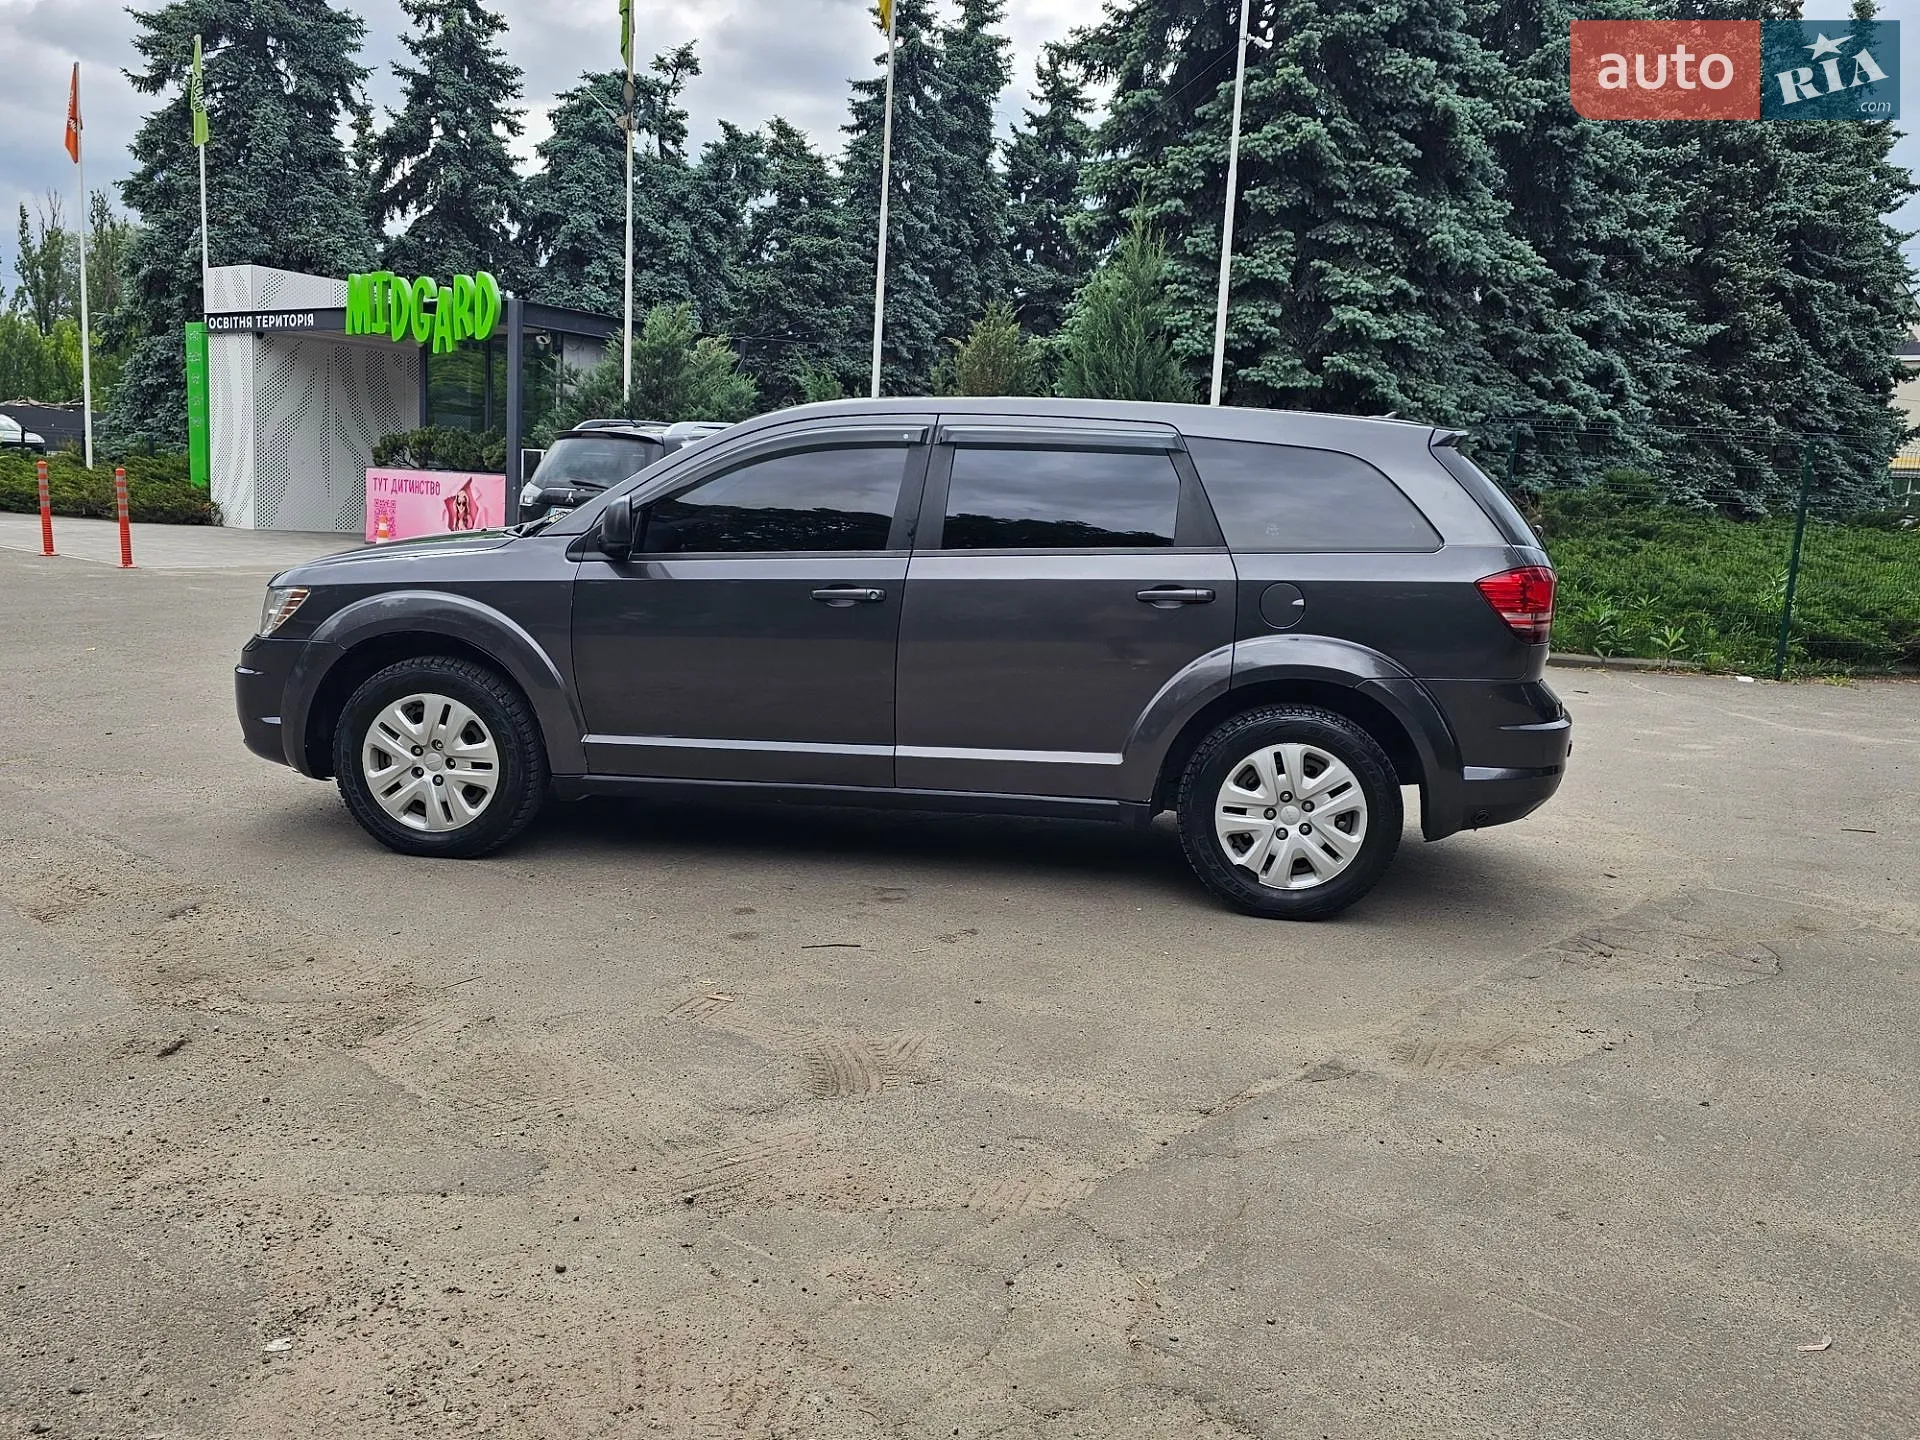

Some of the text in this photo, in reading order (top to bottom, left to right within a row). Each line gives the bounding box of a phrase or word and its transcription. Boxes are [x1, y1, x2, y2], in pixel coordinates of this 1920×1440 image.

[208, 313, 314, 329] ОСВІТНЯ ТЕРИТОРІЯ
[345, 270, 502, 354] MIDGARD
[373, 477, 441, 496] ТУТ ДИТИНСТВО
